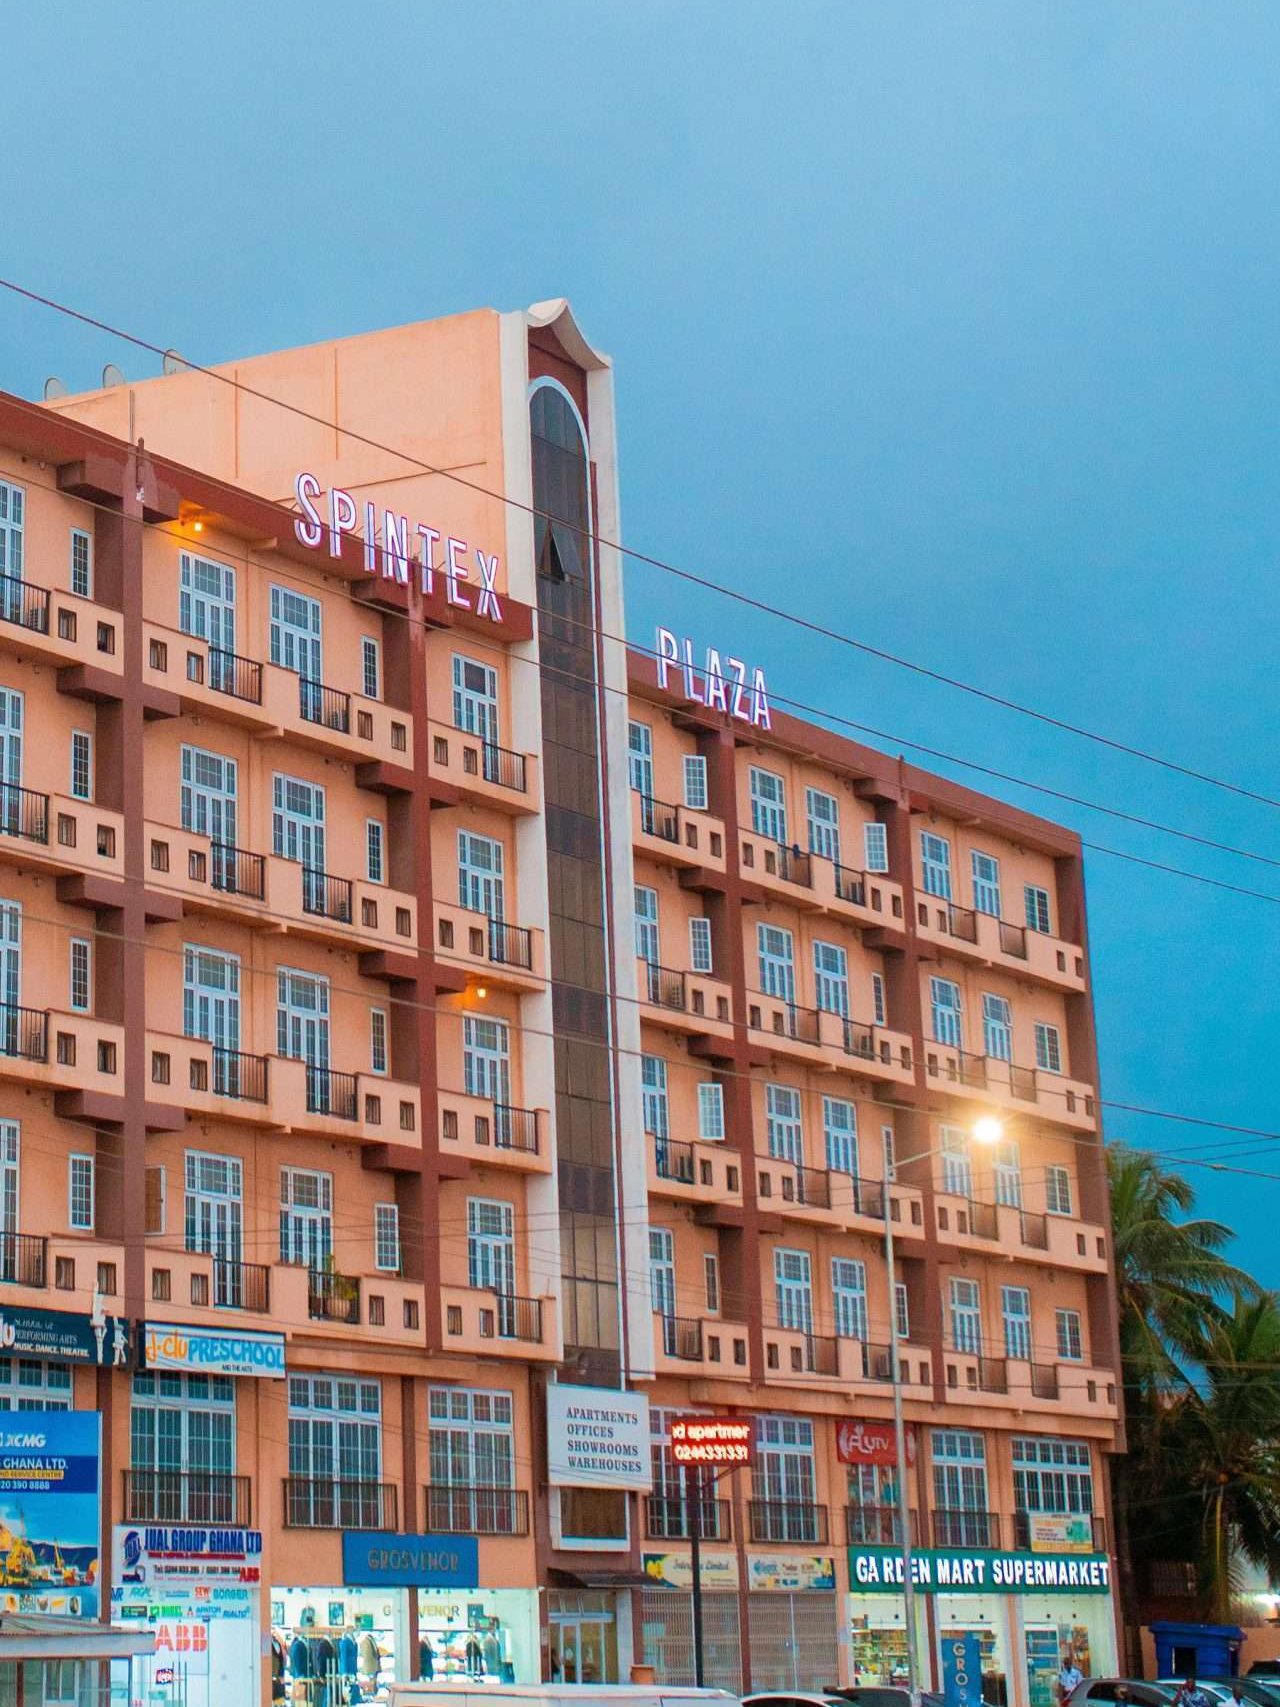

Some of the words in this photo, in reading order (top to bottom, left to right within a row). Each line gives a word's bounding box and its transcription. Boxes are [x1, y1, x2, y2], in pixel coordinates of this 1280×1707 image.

[294, 472, 503, 623] SPINTEX
[656, 626, 772, 731] PLAZA
[15, 1329, 59, 1343] PERFORMING
[59, 1334, 78, 1345] ARTS
[187, 1337, 285, 1369] PRESCHOOL
[566, 1408, 639, 1425] APARTMENTS
[567, 1424, 614, 1439] OFFICES
[5, 1433, 47, 1448] XCMG
[567, 1440, 639, 1456] SHOWROOMS
[674, 1444, 748, 1460] 0244331331
[3, 1458, 43, 1469] GHANA
[45, 1458, 69, 1470] LTD.
[568, 1456, 642, 1472] WAREHOUSES
[12, 1480, 27, 1489] 390
[29, 1481, 50, 1490] 8888
[144, 1528, 170, 1551] JUAL
[171, 1529, 207, 1552] GROUP
[209, 1530, 245, 1553] GHANA
[246, 1531, 262, 1554] LTD
[238, 1567, 260, 1583] ABB
[856, 1555, 932, 1584] GARDEN
[936, 1557, 986, 1585] MART
[992, 1559, 1109, 1586] SUPERMARKET
[154, 1624, 208, 1652] ABB
[953, 1642, 969, 1707] GROS
